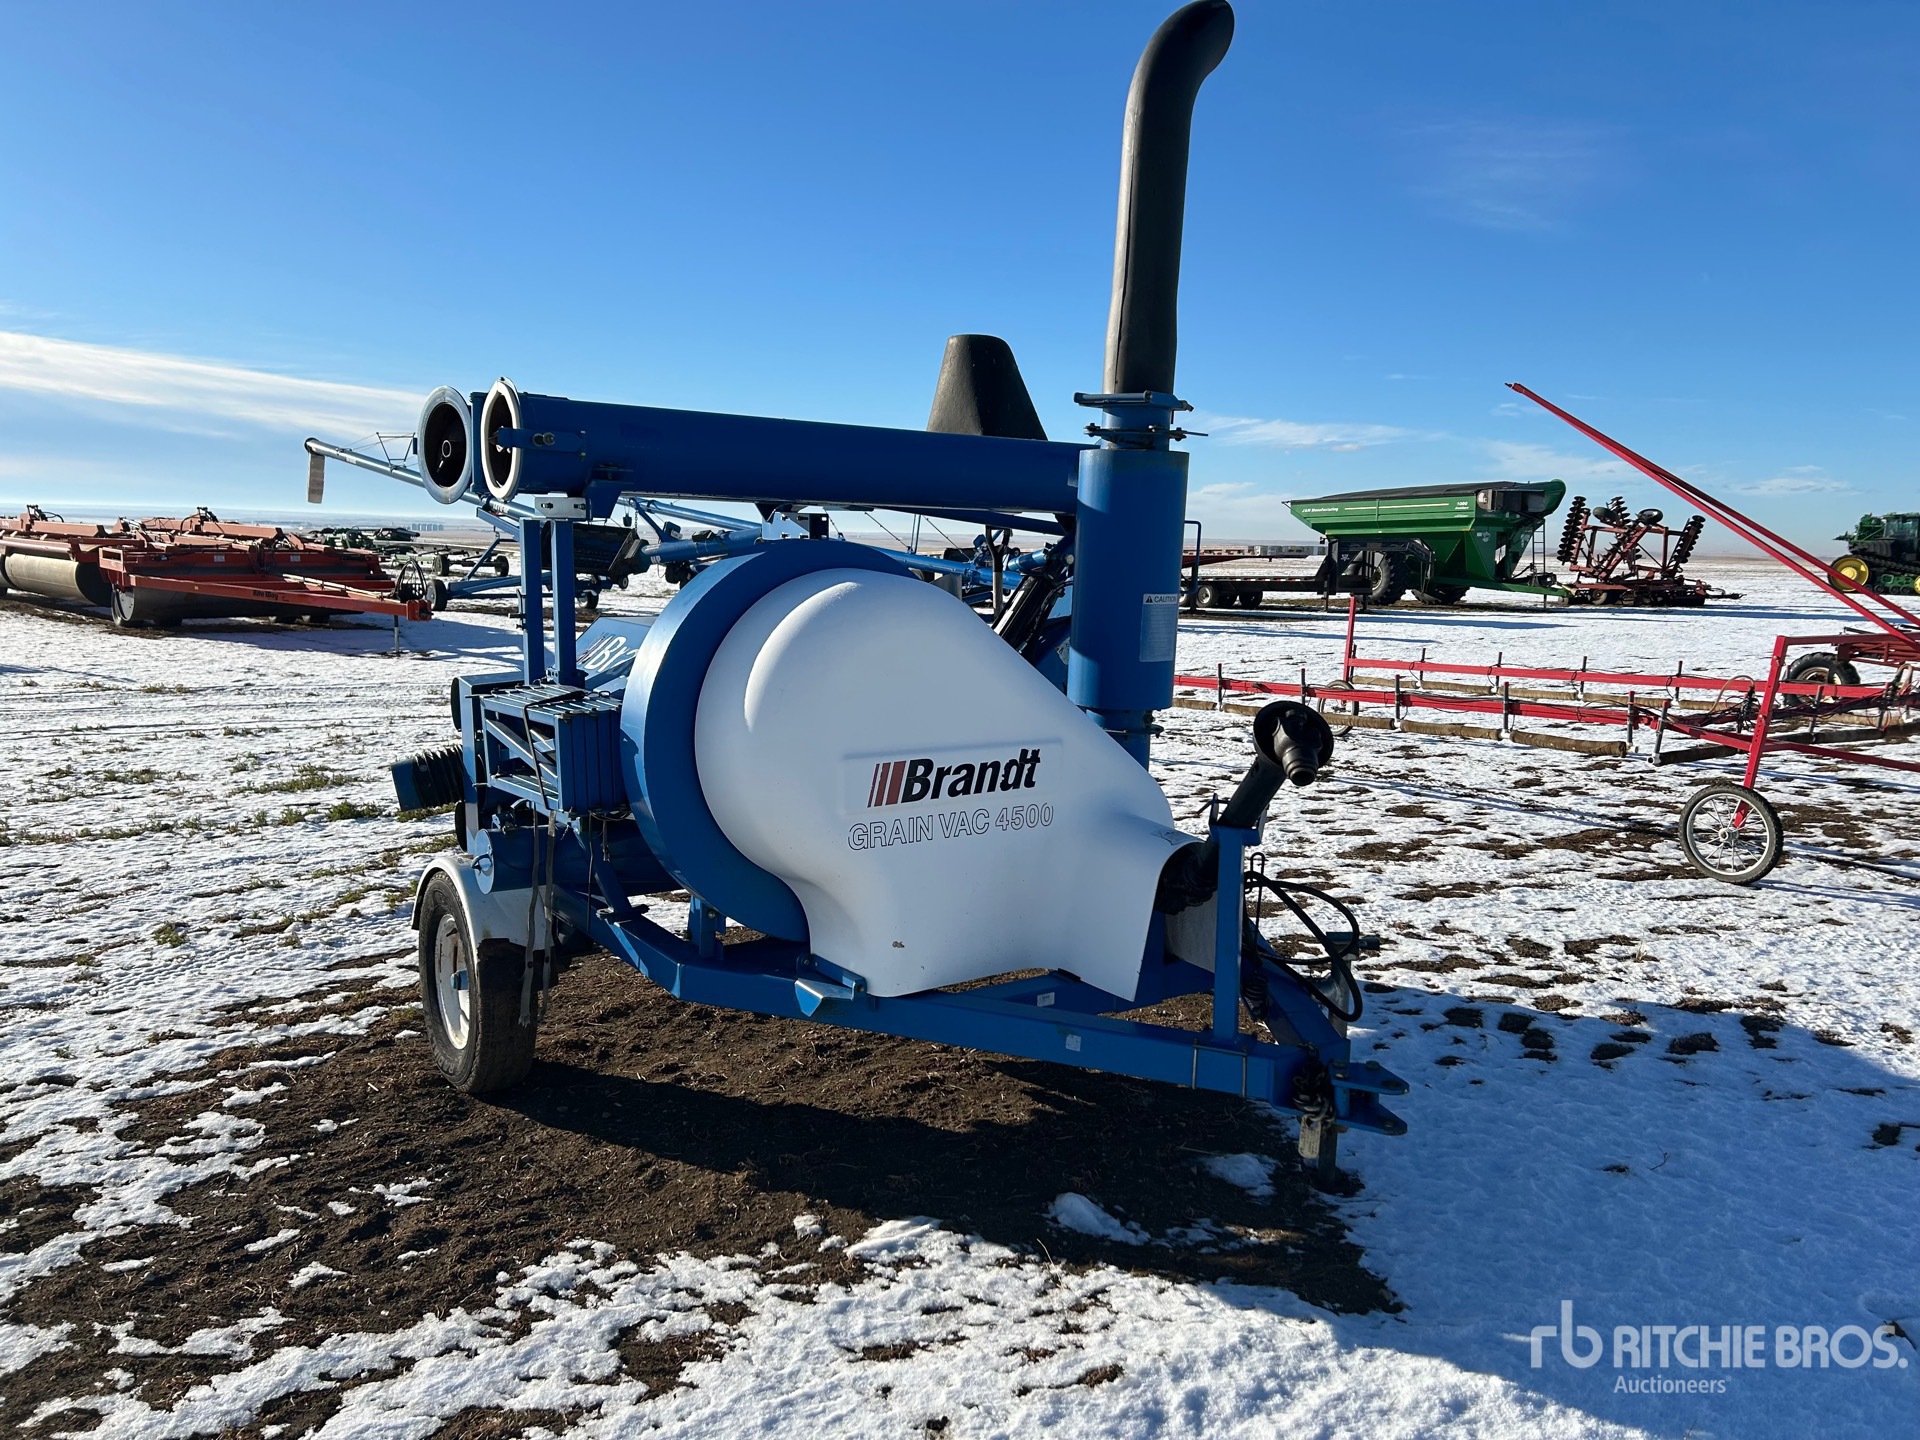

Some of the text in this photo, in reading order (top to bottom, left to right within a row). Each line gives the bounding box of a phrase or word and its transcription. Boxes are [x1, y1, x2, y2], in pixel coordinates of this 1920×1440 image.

[901, 748, 1041, 804] Brandt
[848, 802, 1054, 850] GRAIN VAC 4500
